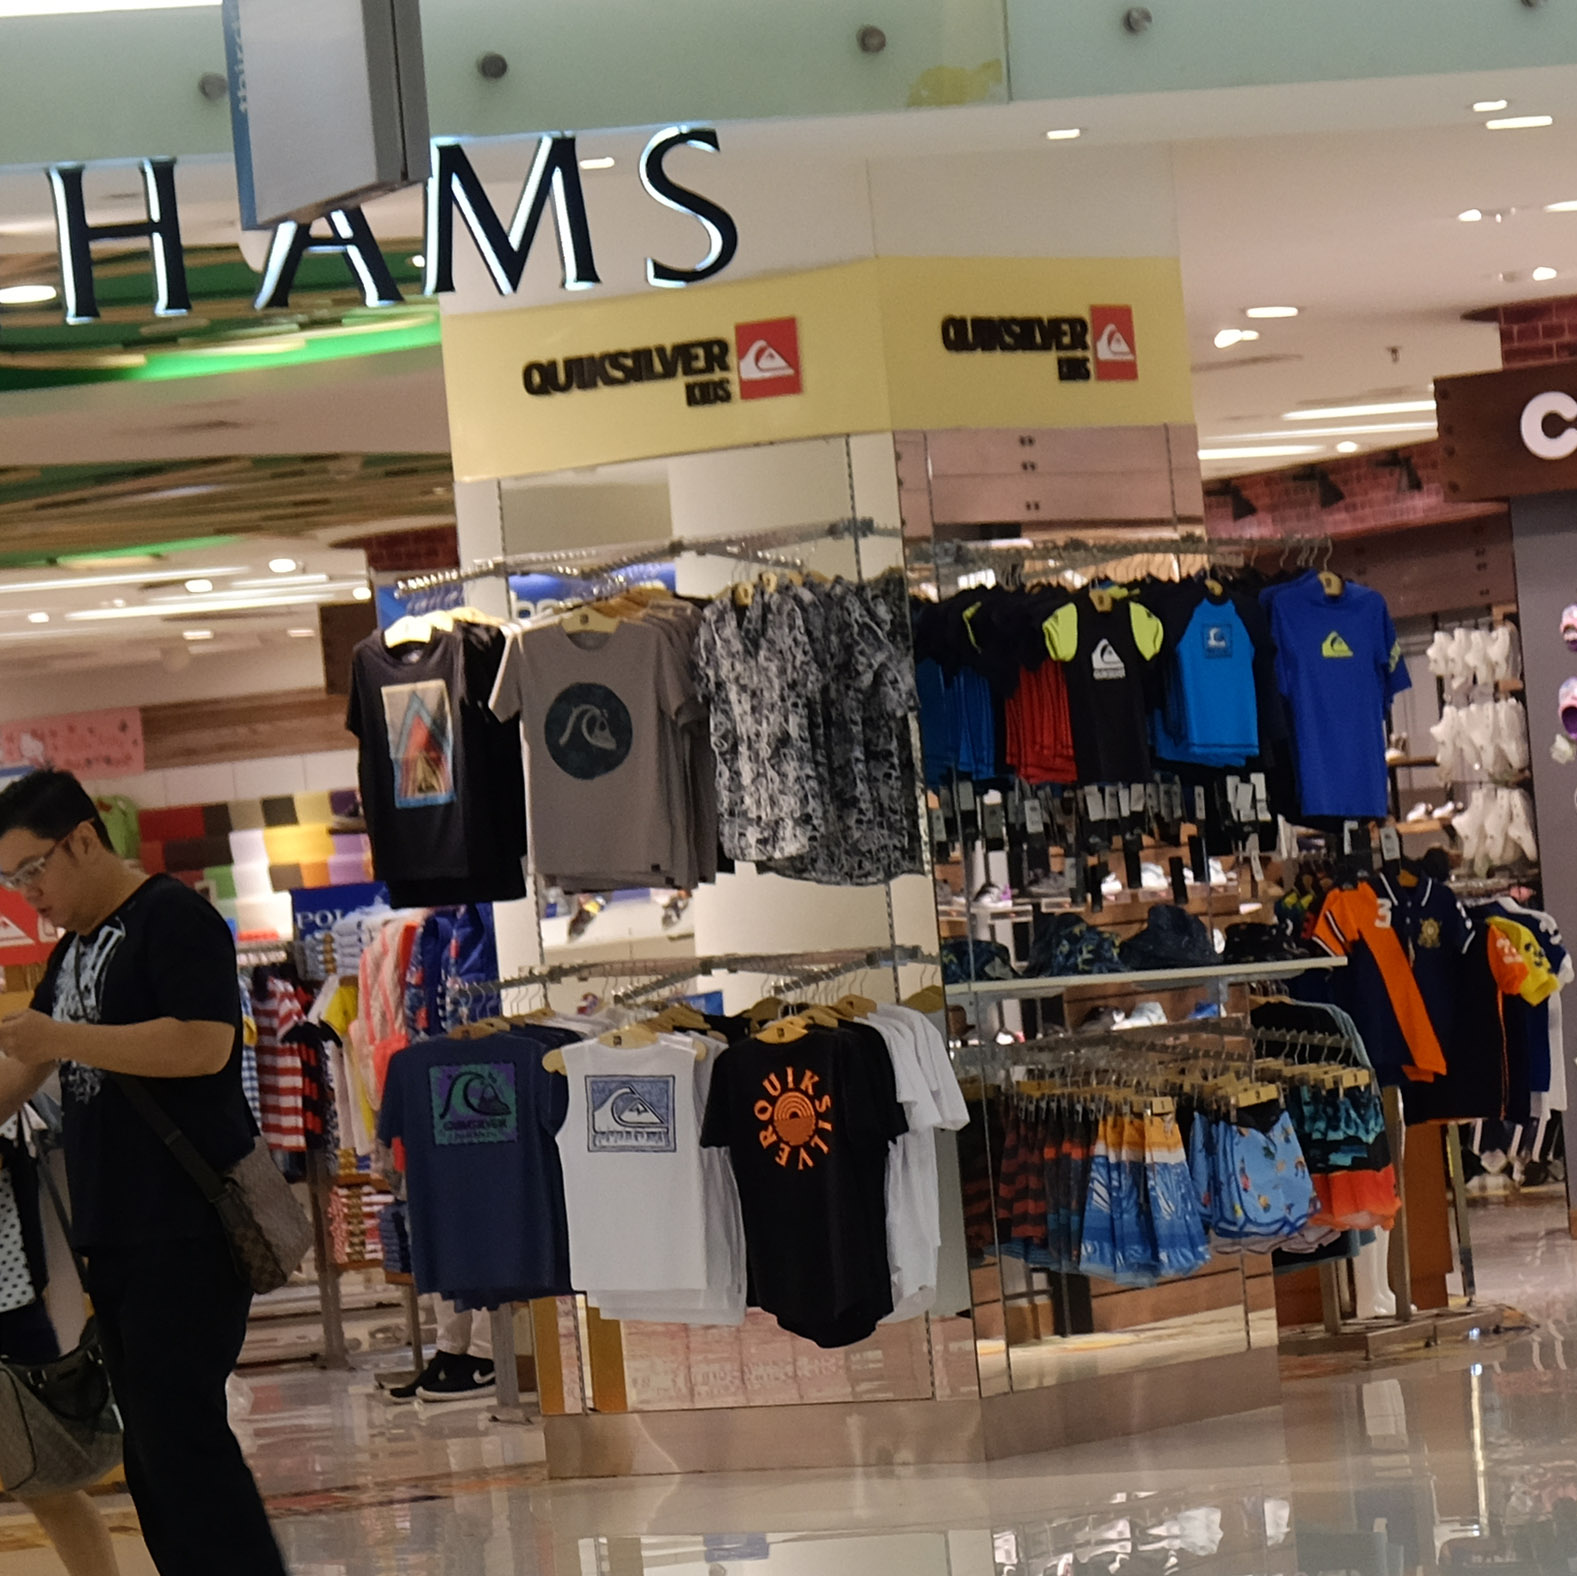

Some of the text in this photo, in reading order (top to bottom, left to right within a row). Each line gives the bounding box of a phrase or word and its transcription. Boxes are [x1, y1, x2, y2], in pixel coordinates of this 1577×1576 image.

[941, 316, 1089, 352] QUIKSILVER
[523, 337, 730, 395] QUIKSILVER
[685, 380, 732, 407] KIDS
[754, 1065, 832, 1170] QUIKSILVER
